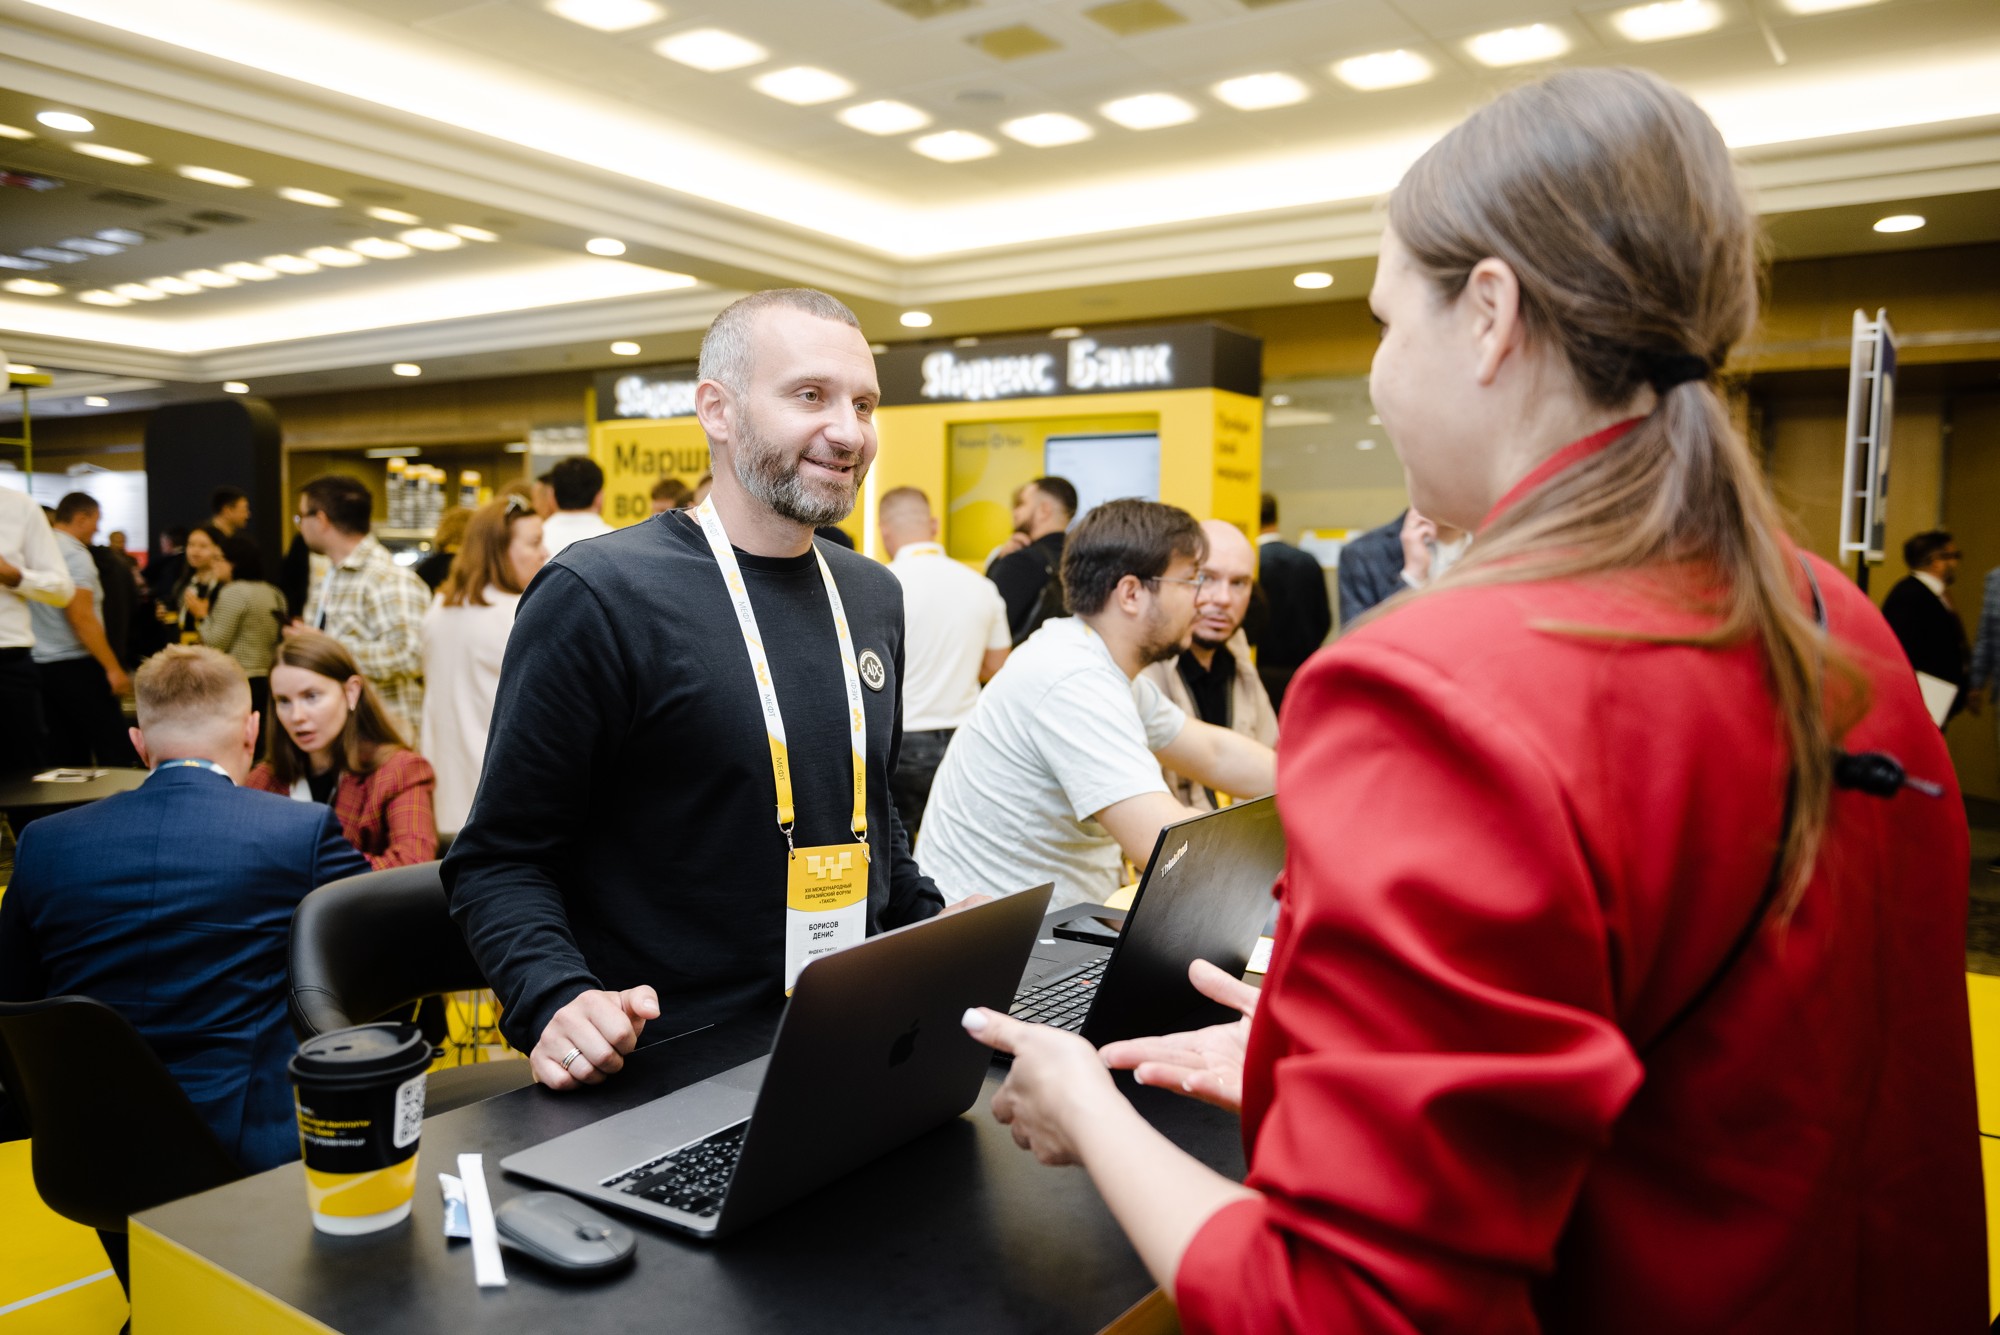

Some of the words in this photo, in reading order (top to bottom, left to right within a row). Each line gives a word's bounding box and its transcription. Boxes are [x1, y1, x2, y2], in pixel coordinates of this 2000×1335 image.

[921, 351, 1056, 401] Яндекс
[1066, 338, 1172, 389] Банк
[738, 600, 752, 623] МЕФТ
[850, 678, 858, 701] МЕФТ
[764, 693, 776, 718] МЕФТ
[776, 757, 786, 782] МЕФТ
[1161, 840, 1188, 878] ThinkPad
[812, 883, 852, 892] МЕЖДУНАРОДНЫЙ
[808, 921, 839, 931] БОРИСОВ
[812, 930, 834, 940] ДЕНИС
